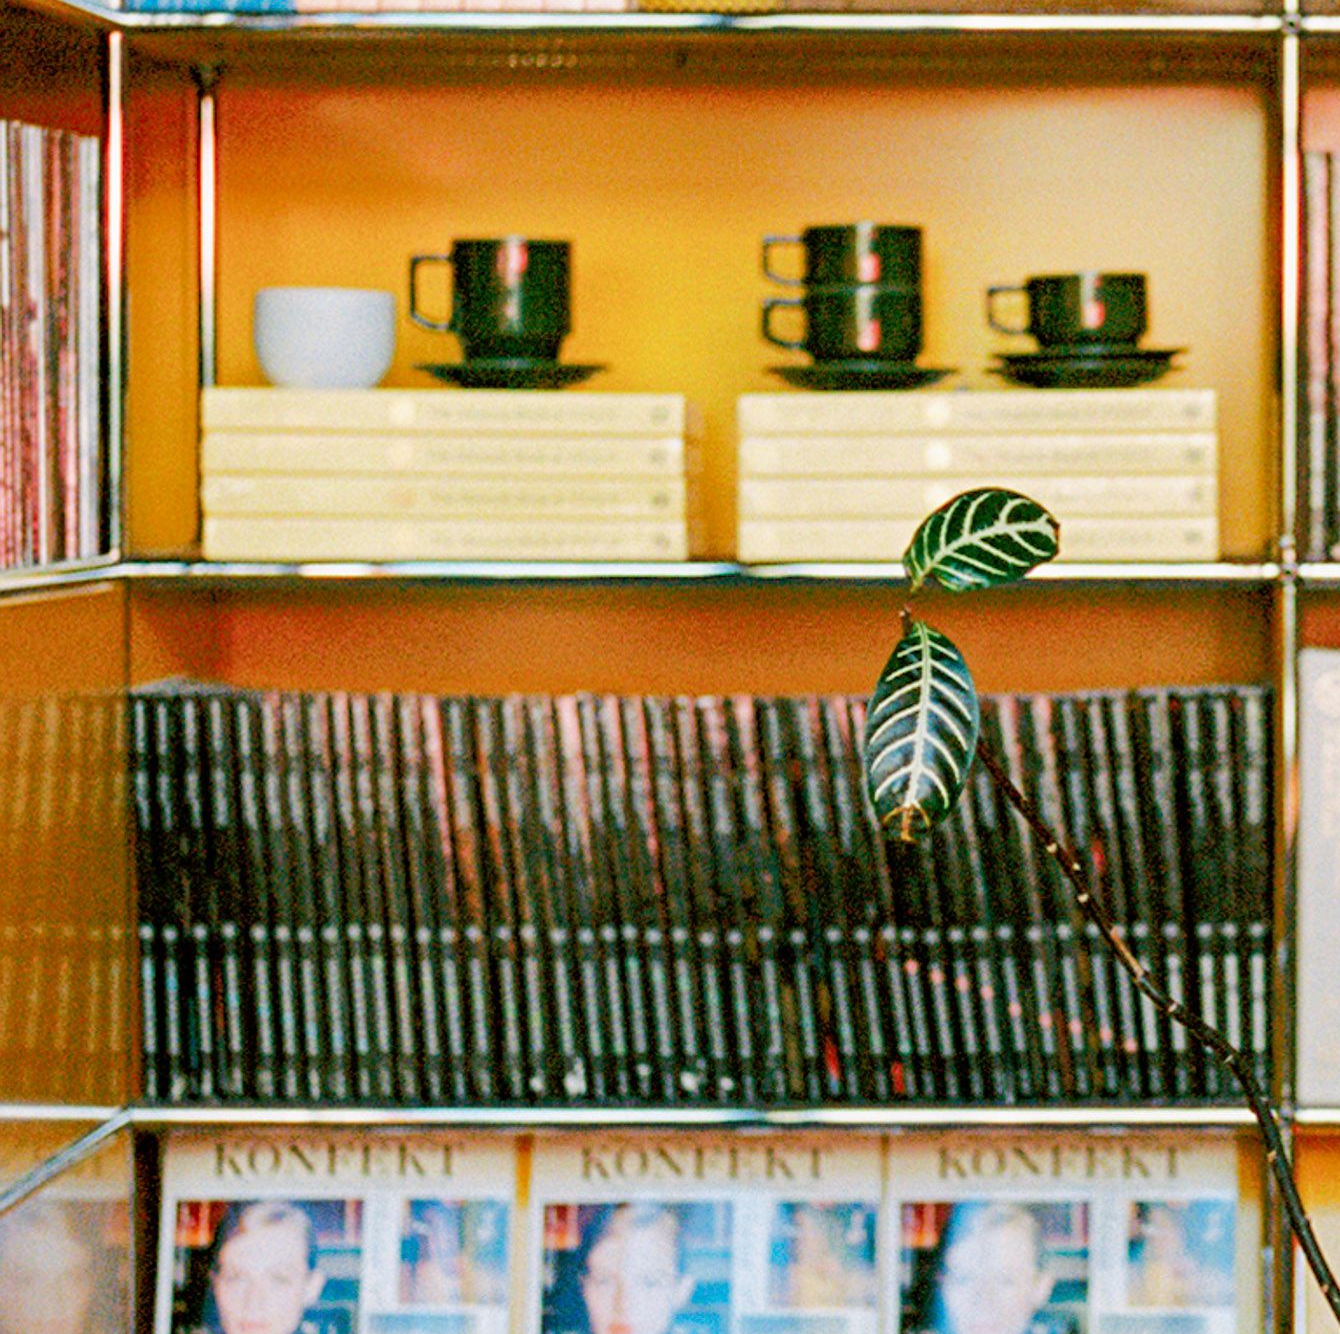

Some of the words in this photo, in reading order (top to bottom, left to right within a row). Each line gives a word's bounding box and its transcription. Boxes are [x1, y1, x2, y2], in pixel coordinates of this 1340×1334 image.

[213, 1143, 457, 1178] KONFEKT
[581, 1145, 823, 1180] KONFEKT
[938, 1145, 1179, 1179] KONFEKT
